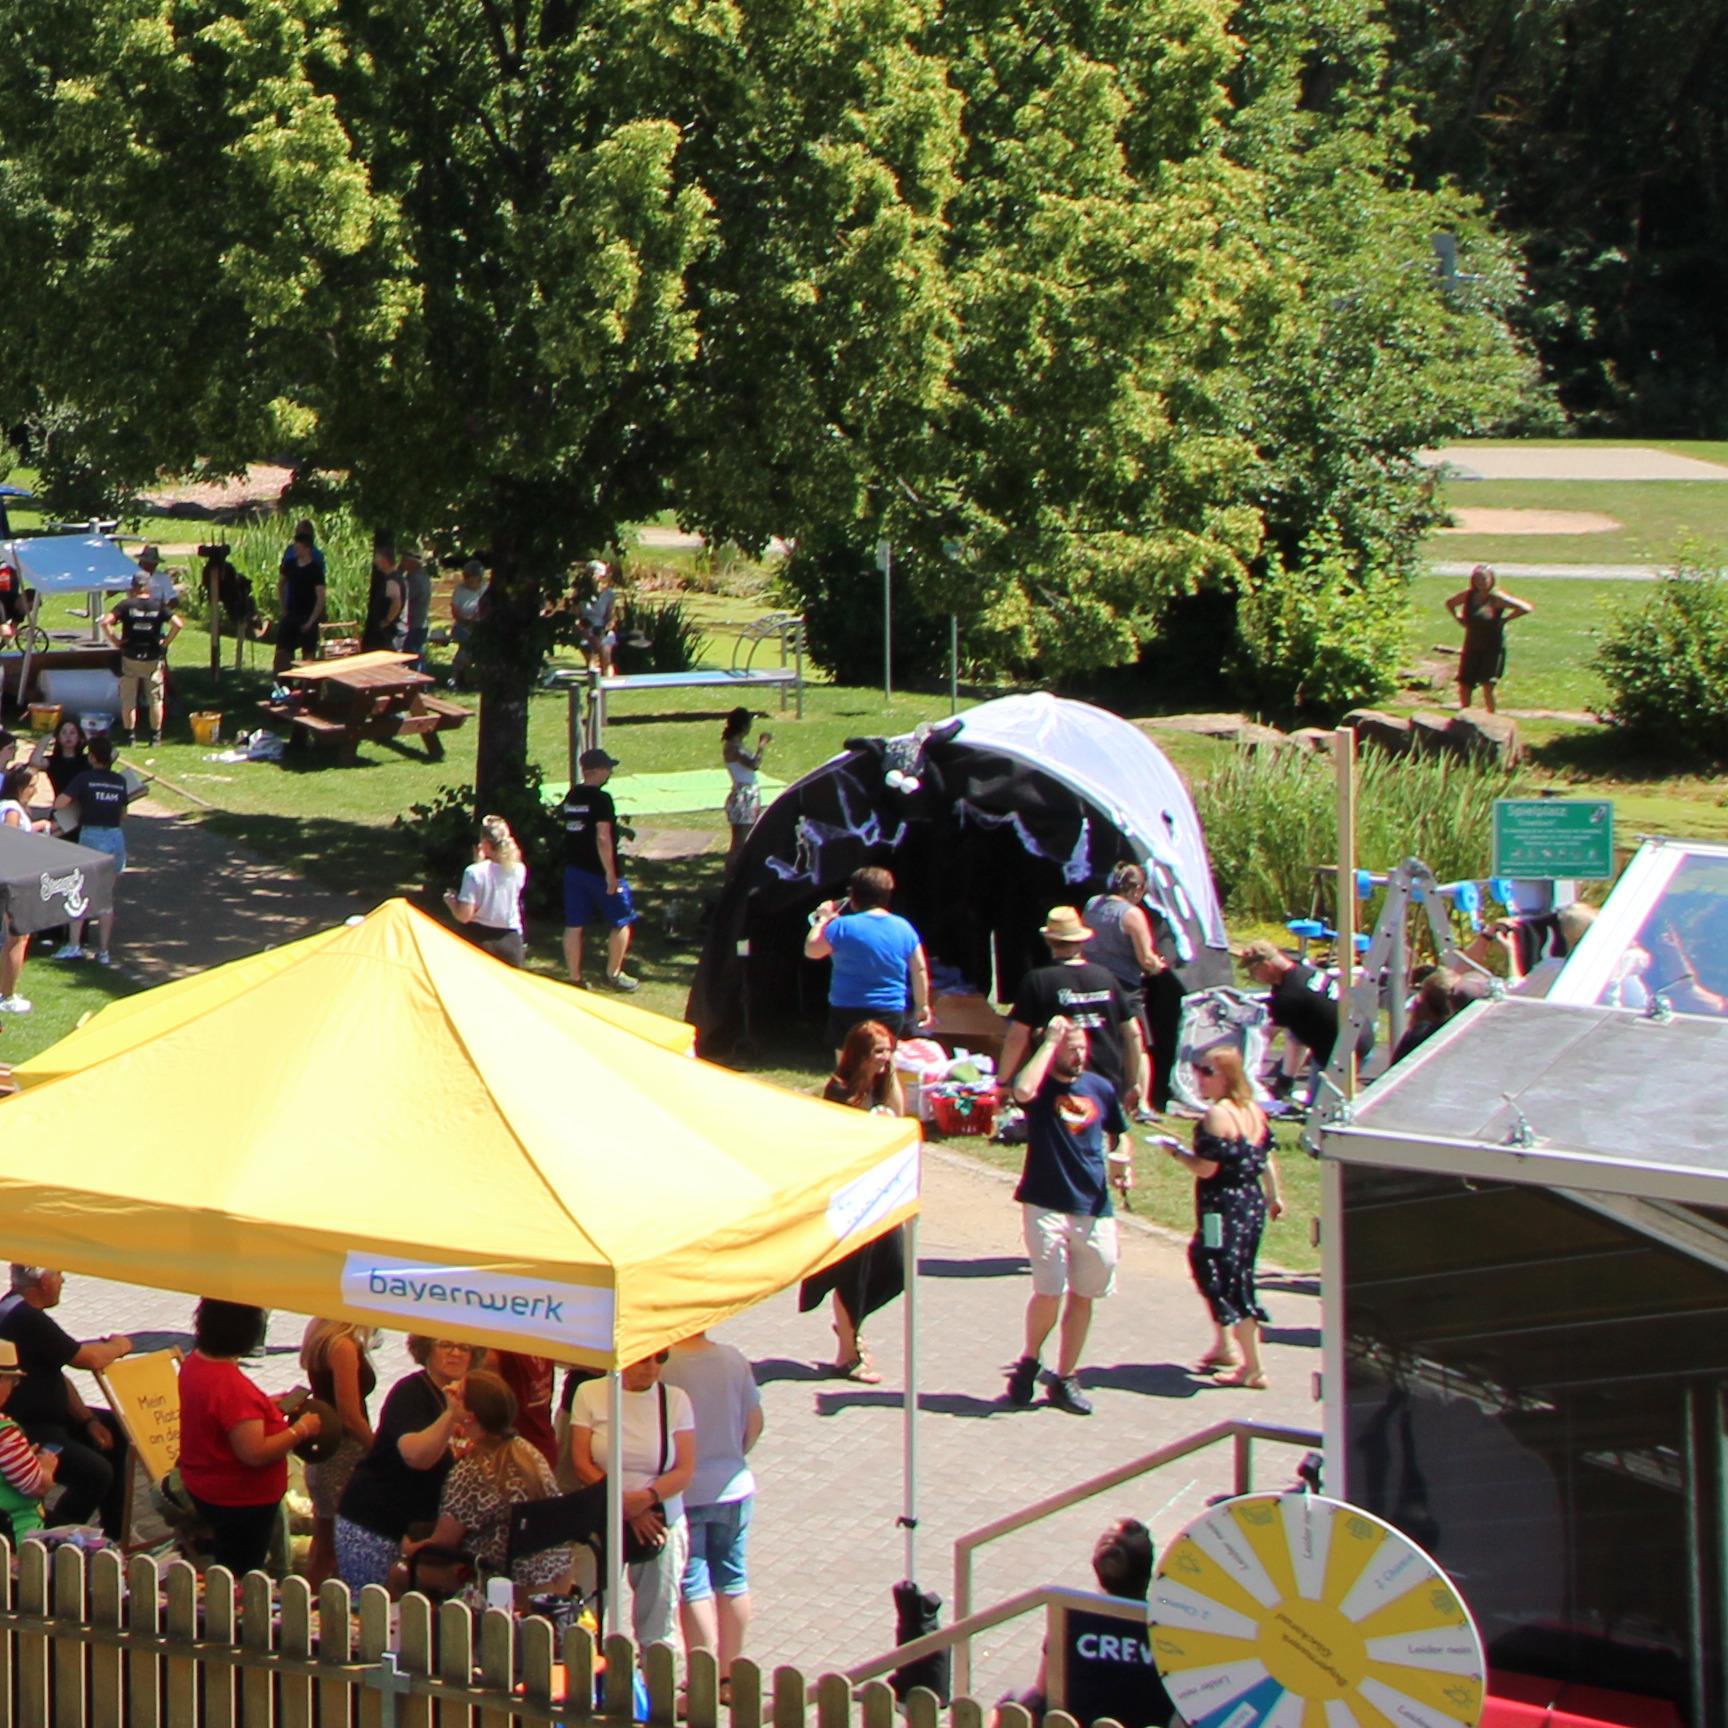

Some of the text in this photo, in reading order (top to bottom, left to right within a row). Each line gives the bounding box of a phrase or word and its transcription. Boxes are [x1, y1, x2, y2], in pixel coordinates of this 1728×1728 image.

[95, 791, 119, 802] TEAM
[369, 1267, 564, 1323] bayernwerk
[137, 1395, 167, 1410] Mein
[154, 1409, 180, 1425] Plat
[149, 1427, 180, 1444] an de
